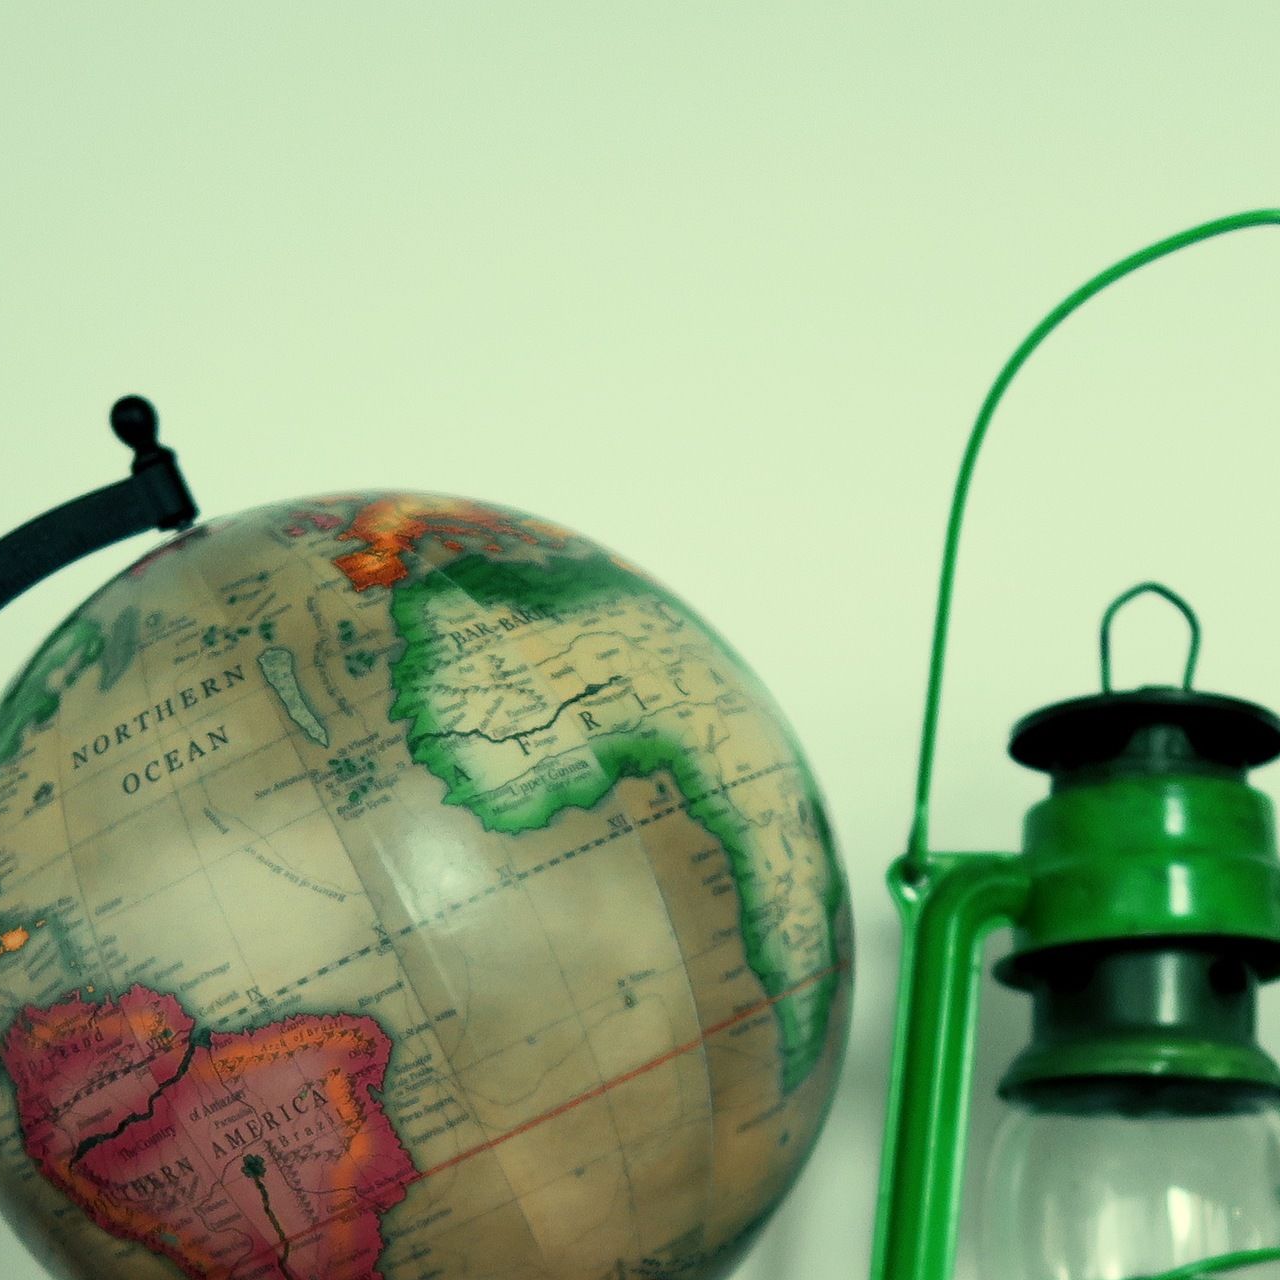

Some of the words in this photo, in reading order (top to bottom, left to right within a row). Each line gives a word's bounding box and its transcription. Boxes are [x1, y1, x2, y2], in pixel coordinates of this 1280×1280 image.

[70, 664, 247, 770] NORTHERN
[121, 725, 230, 795] OCEAN
[508, 772, 545, 798] Upper
[246, 986, 264, 1003] IX
[211, 1088, 328, 1160] AMERICA
